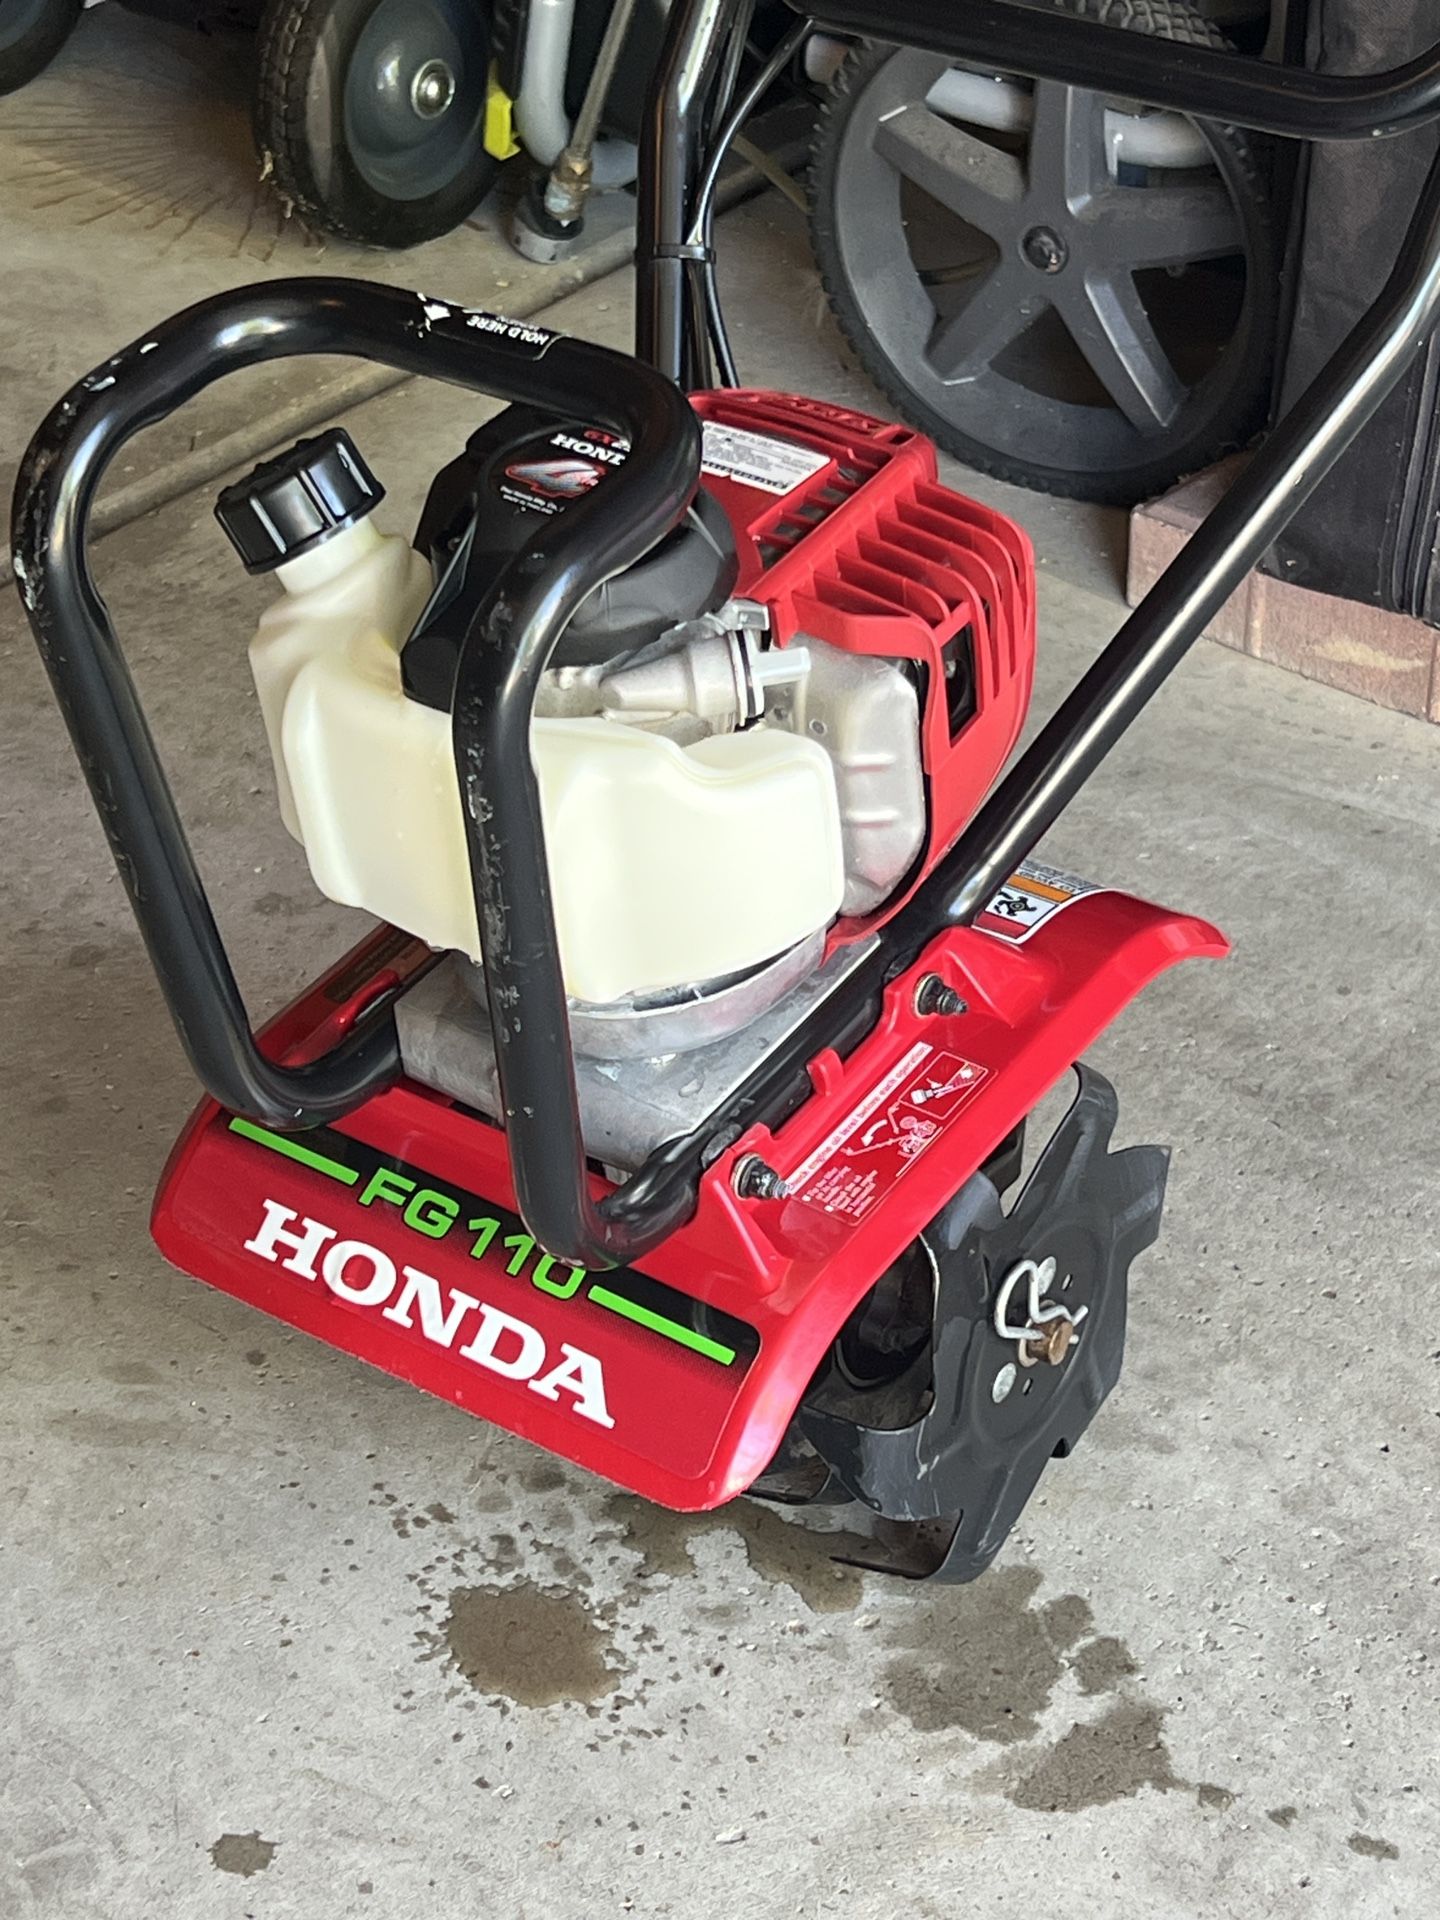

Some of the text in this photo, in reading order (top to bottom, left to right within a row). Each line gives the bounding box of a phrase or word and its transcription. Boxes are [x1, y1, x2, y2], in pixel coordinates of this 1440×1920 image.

[466, 315, 508, 333] HERE
[508, 326, 549, 346] HOLD
[549, 433, 627, 466] HON
[880, 1078, 895, 1096] each
[243, 1198, 617, 1430] HONDA
